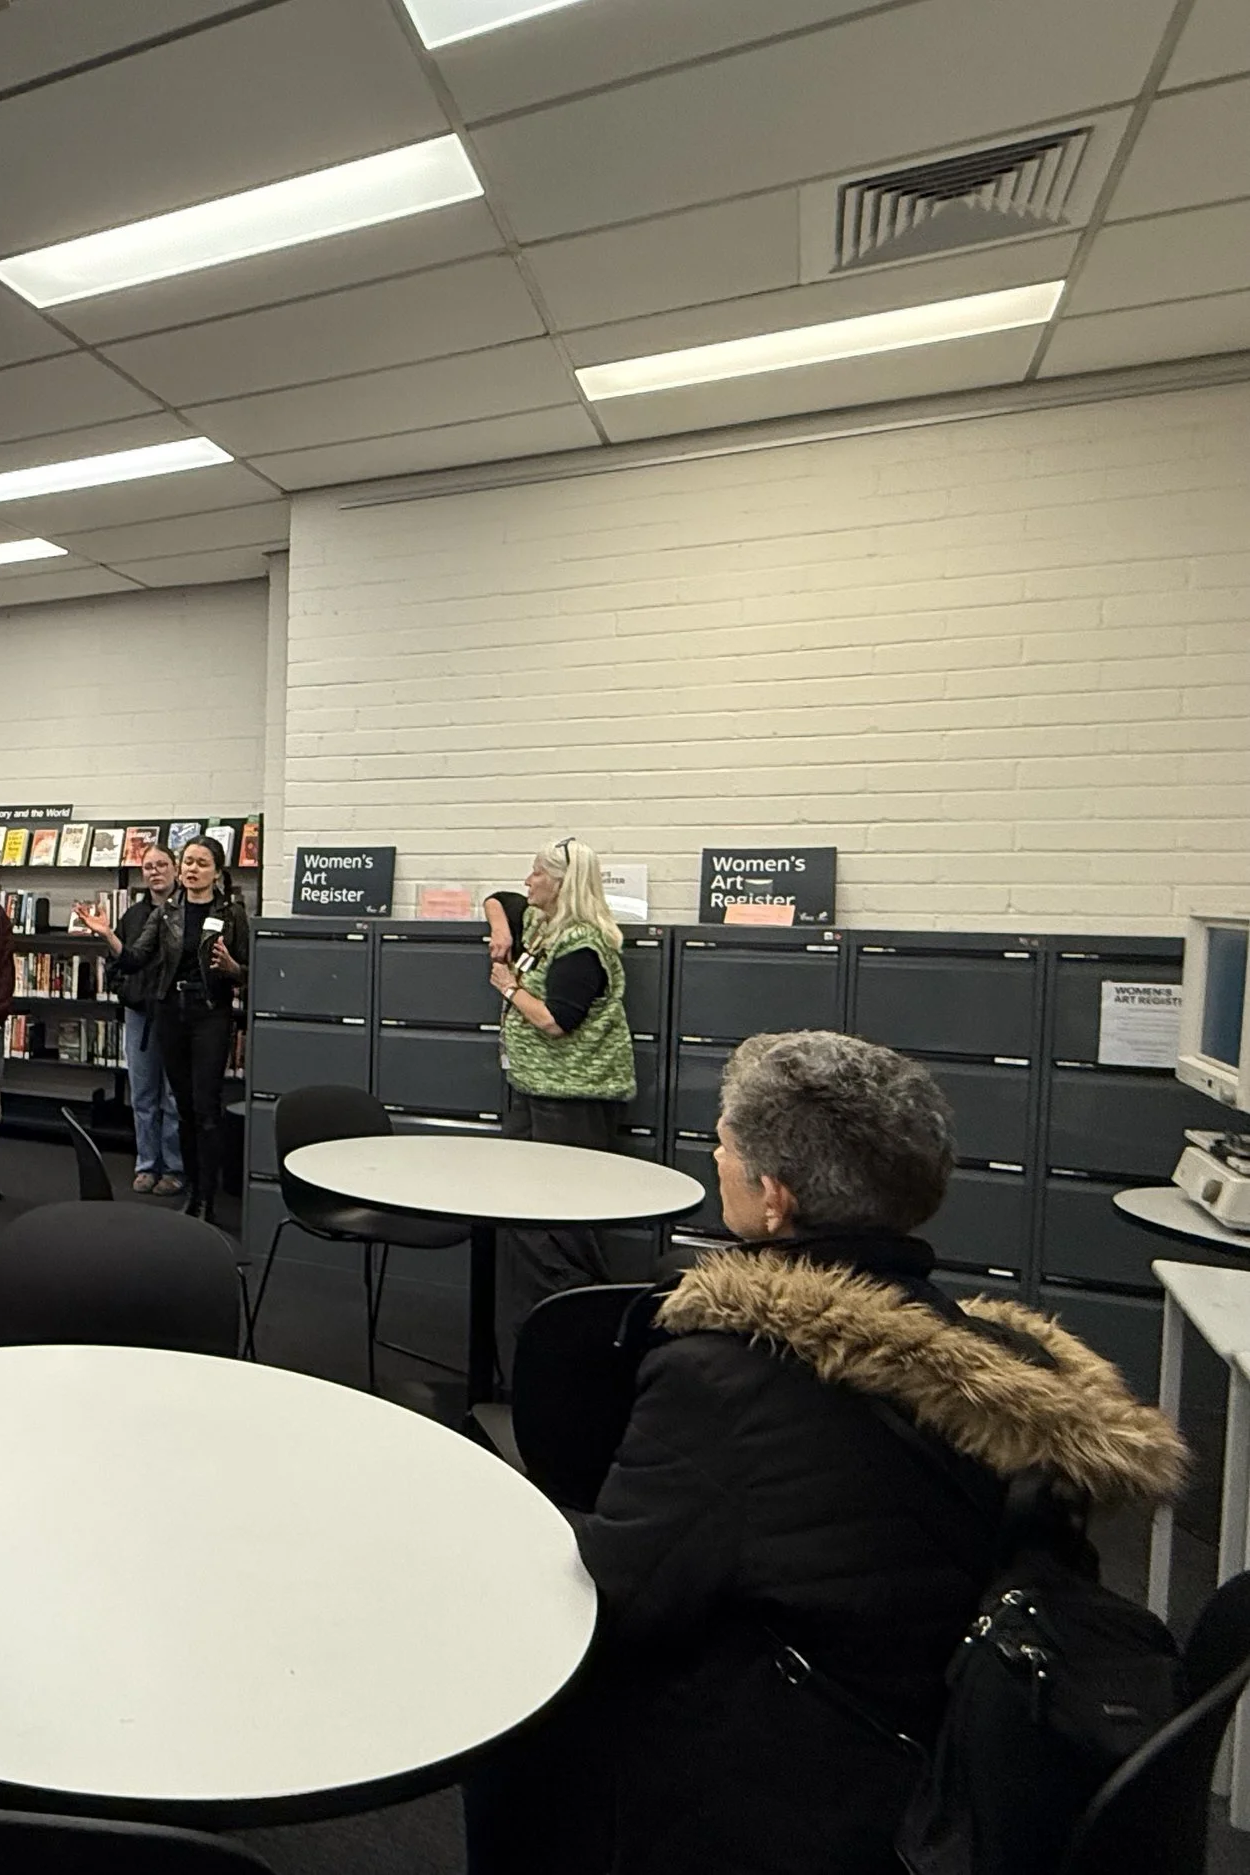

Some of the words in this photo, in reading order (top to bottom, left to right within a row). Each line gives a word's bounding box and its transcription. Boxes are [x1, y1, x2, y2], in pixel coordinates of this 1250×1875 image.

[13, 809, 29, 818] and
[31, 808, 45, 818] the
[46, 807, 70, 818] World
[304, 854, 374, 870] Women's
[712, 856, 807, 873] Women's
[301, 871, 327, 886] Art
[710, 875, 744, 891] Art
[301, 887, 365, 904] Register
[710, 892, 796, 908] Register
[1114, 986, 1173, 997] WOMEN'S
[1114, 995, 1137, 1005] ART
